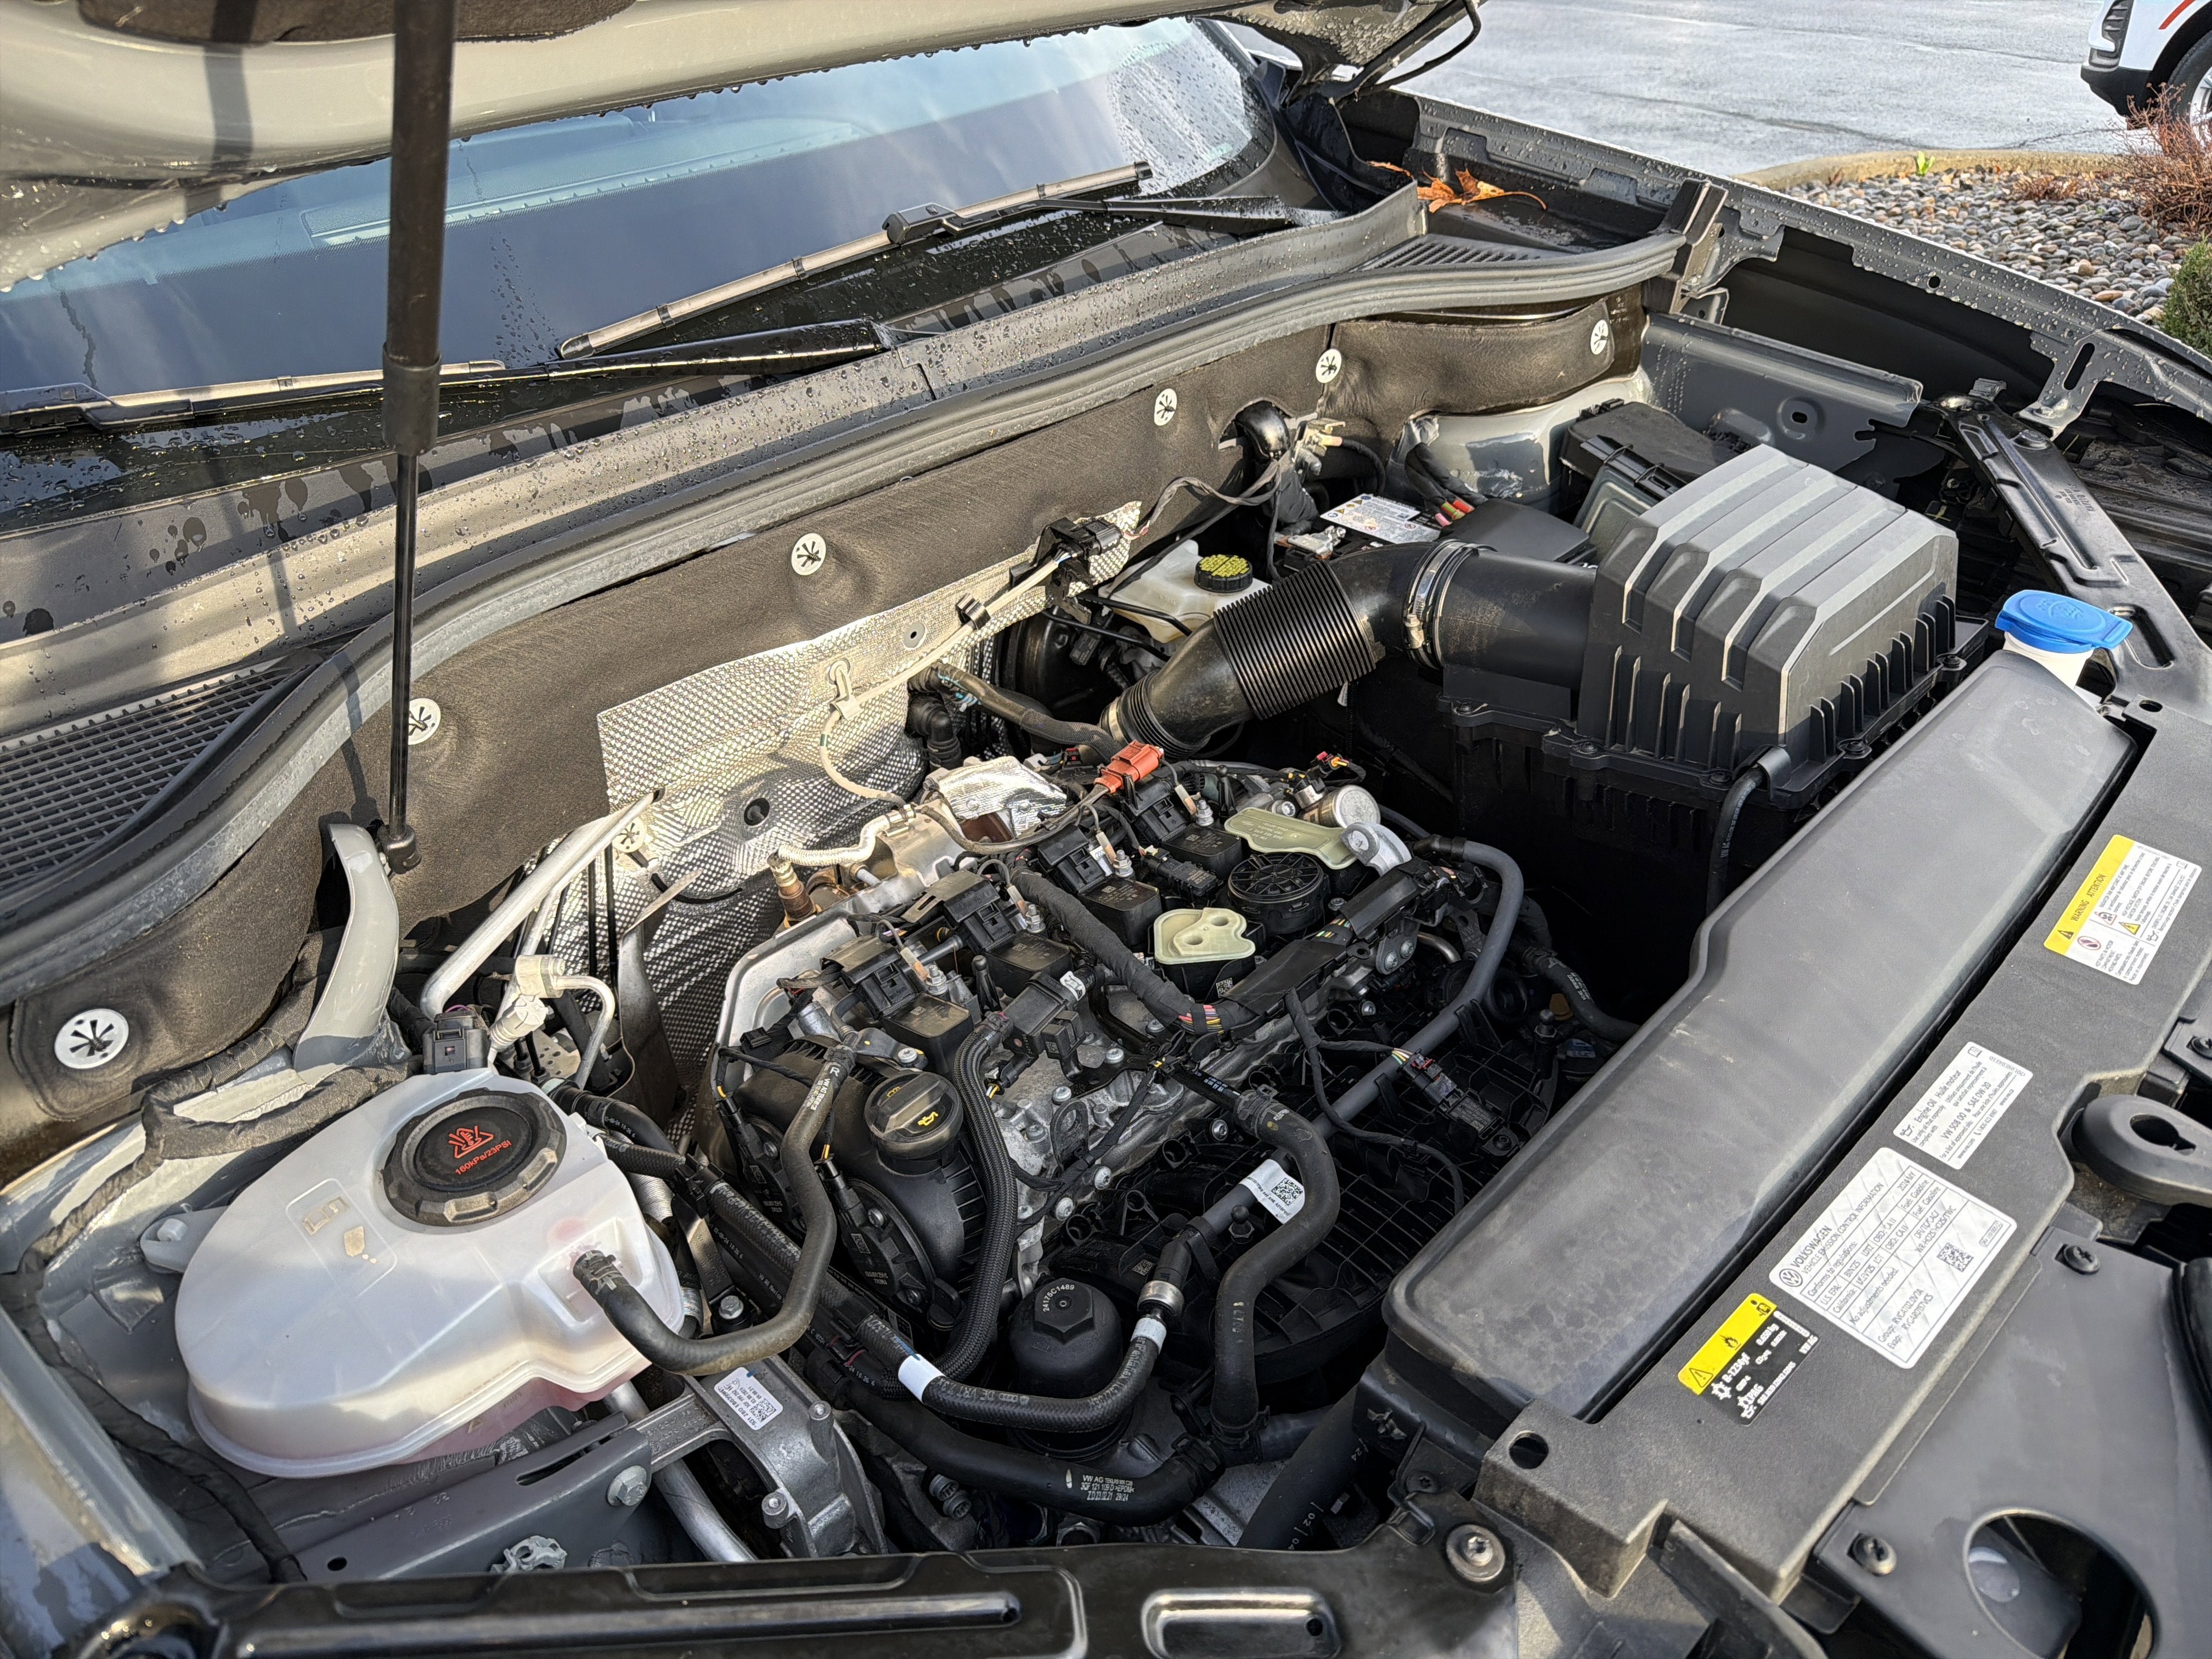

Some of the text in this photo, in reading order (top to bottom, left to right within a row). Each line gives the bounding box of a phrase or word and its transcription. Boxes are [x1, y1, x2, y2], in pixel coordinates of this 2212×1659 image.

[2070, 873, 2106, 922] WARNING ATTENTION
[1934, 1069, 1962, 1098] Huile moteur
[1914, 1098, 1937, 1124] Engine Oil
[1940, 1127, 1954, 1140] VW
[1948, 1118, 1961, 1131] 508
[1956, 1111, 1967, 1121] 00
[1966, 1096, 1979, 1108] SAE
[1974, 1080, 1992, 1099] 0W-20
[455, 1139, 511, 1176] 160kPa/23PSI
[1905, 1171, 1916, 1181] MY
[1900, 1178, 1929, 1210] Fuel: Gasoline
[1912, 1185, 1942, 1217] Fuel: Gasoline
[1801, 1182, 1884, 1275] VEHICLE EMISSION CONTROL INFORMATION
[1883, 1221, 1894, 1230] CA
[1895, 1228, 1906, 1238] CA
[1790, 1224, 1833, 1269] VOLKSWAGEN
[1807, 1272, 1831, 1297] Conforms
[1831, 1239, 1859, 1269] regulations:
[768, 1284, 784, 1300] Mexico
[1832, 1286, 1857, 1314] California:
[1849, 1267, 1899, 1325] No adjustments needed.
[1806, 1334, 1819, 1345] AG
[1877, 1323, 1898, 1344] Group:
[1886, 1332, 1904, 1351] Evap:
[1302, 1513, 1316, 1527] 02
